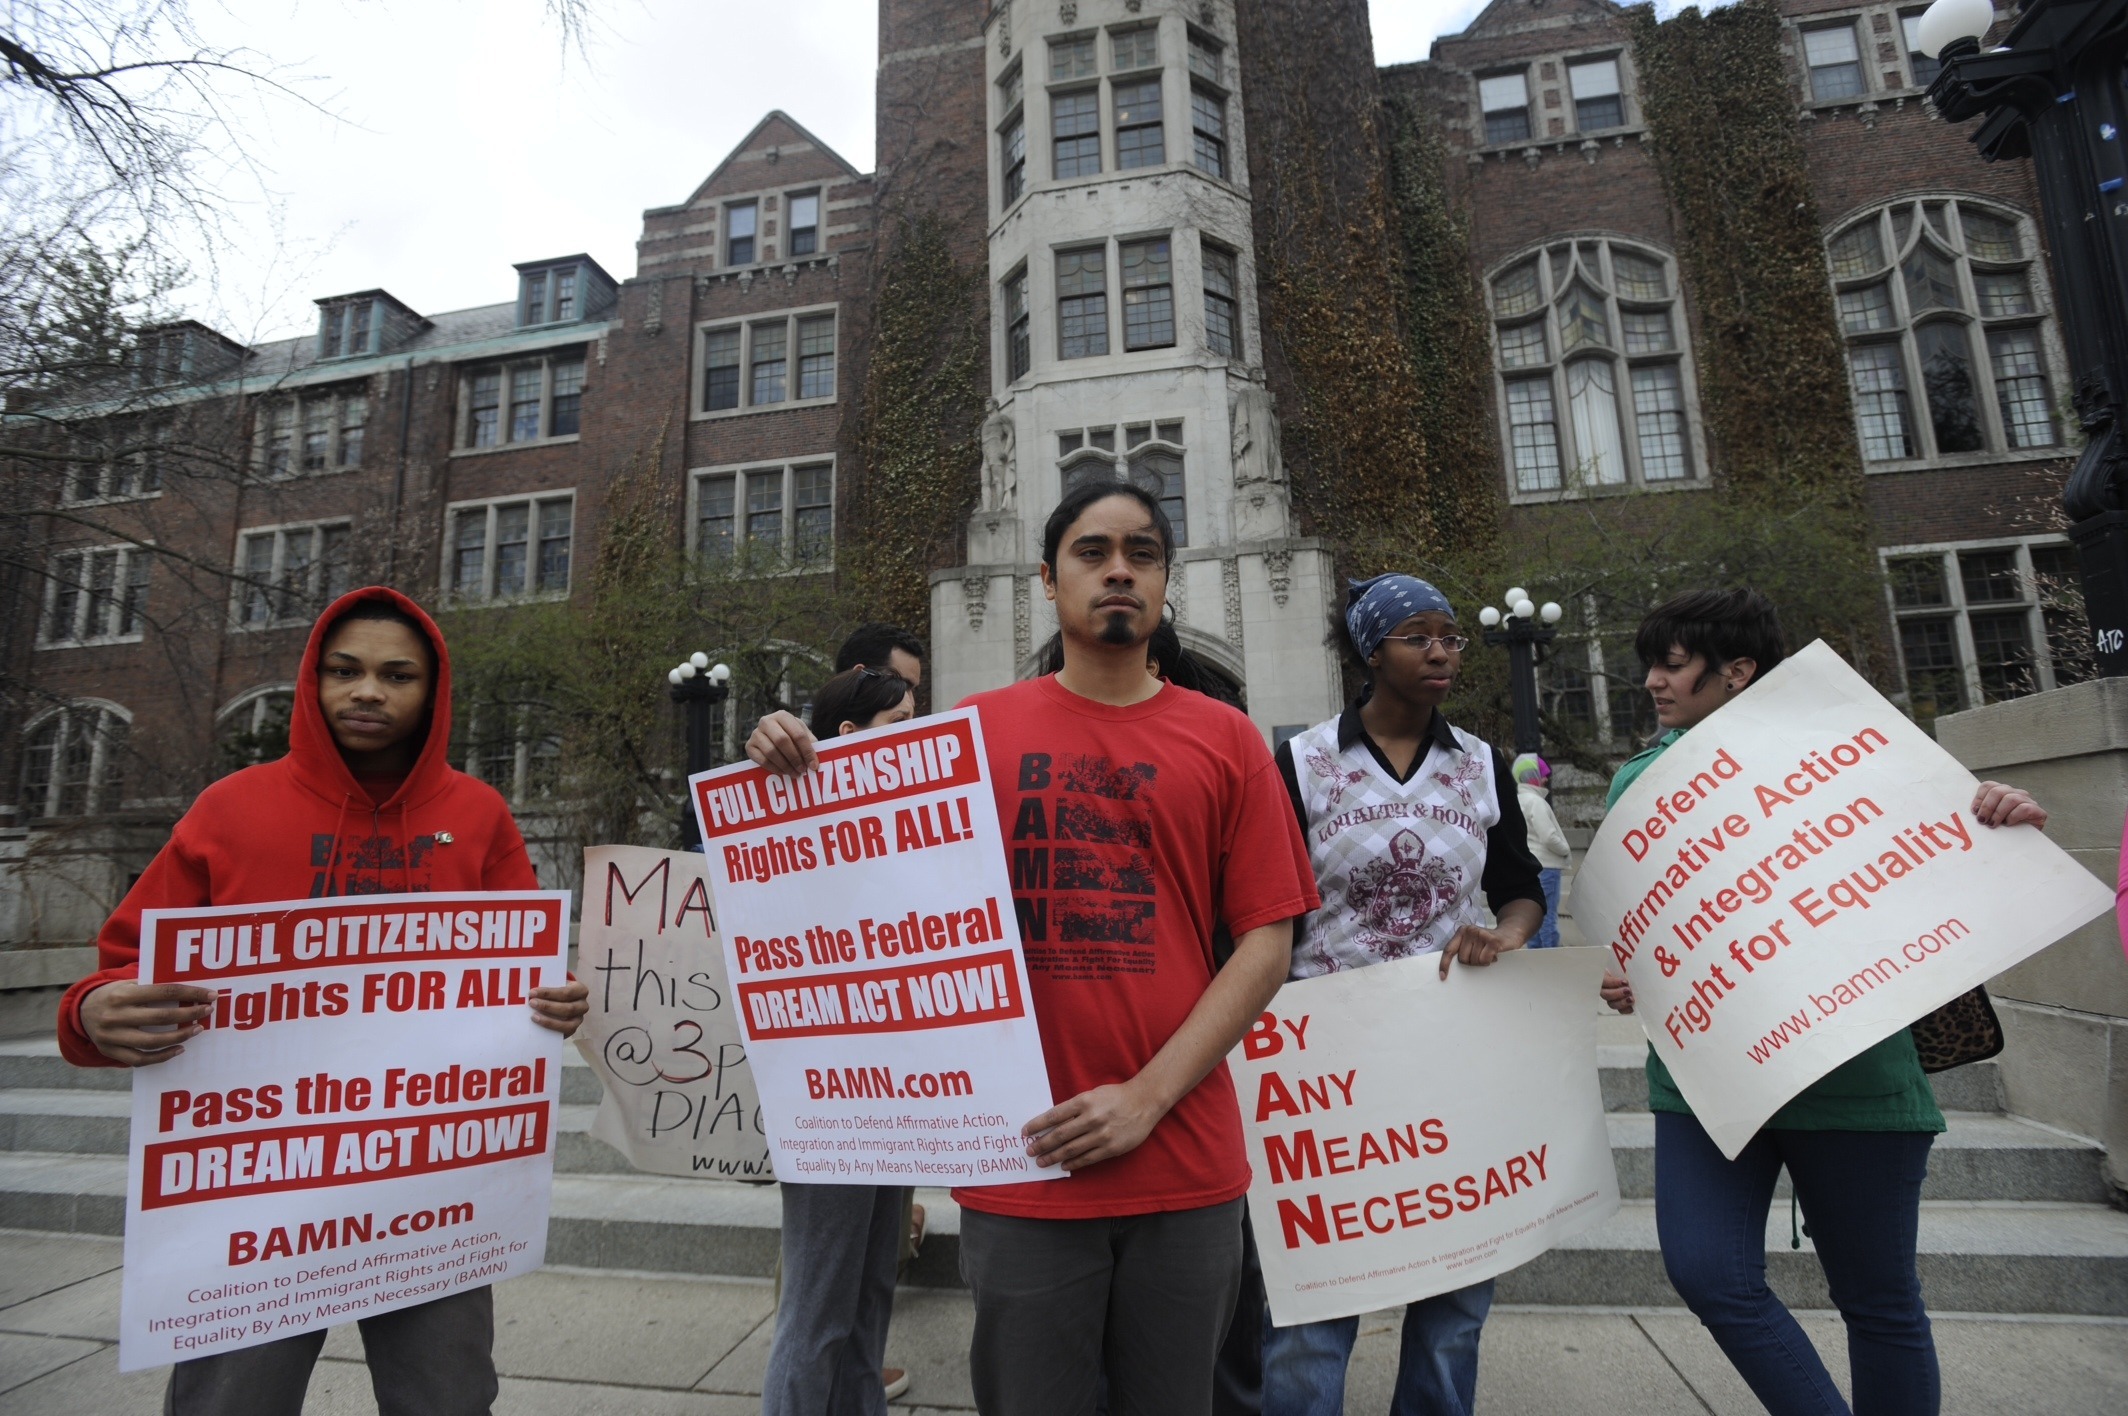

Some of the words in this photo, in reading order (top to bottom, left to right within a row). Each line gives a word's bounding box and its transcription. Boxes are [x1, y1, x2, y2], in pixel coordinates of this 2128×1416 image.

[706, 780, 767, 828] FULL
[765, 734, 961, 814] CITIZENSHIP
[1622, 748, 1743, 862] Defend
[723, 835, 817, 883] Rights
[819, 816, 887, 866] FOR
[895, 797, 974, 853] ALL!
[1318, 802, 1410, 844] LOYALTY
[1413, 803, 1428, 818] &
[1611, 813, 1750, 973] Affirmative
[1753, 727, 1889, 818] Action
[605, 857, 716, 938] MA
[1654, 945, 1681, 978] &
[1672, 796, 1884, 951] Integration
[175, 922, 281, 973] FULL
[293, 909, 547, 960] CITIZENSHIP
[734, 935, 804, 974] Pass
[805, 925, 857, 965] the
[858, 896, 1003, 960] Federal
[1665, 963, 1736, 1049] Fight
[1728, 918, 1791, 973] for
[1788, 811, 1973, 928] Equality
[362, 971, 446, 1013] FOR
[595, 939, 721, 1012] this
[748, 984, 845, 1030] DREAM
[846, 979, 902, 1024] ACT
[907, 963, 1010, 1019] NOW!
[1747, 918, 1970, 1064] www.bamn.com
[1242, 1011, 1310, 1061] BY
[159, 1084, 283, 1133] Pass
[296, 1073, 371, 1115] the
[384, 1057, 546, 1109] Federal
[805, 1066, 973, 1100] BAMN.com
[1256, 1069, 1356, 1122] ANY
[160, 1136, 325, 1197] DREAM
[333, 1127, 419, 1176] ACT
[428, 1112, 537, 1163] NOW!
[779, 1138, 834, 1153] Integration
[837, 1139, 856, 1151] and
[859, 1137, 916, 1154] Immigrant
[917, 1137, 954, 1155] Rights
[957, 1136, 980, 1151] and
[984, 1135, 1018, 1152] Fight
[794, 1116, 839, 1129] Coalition
[841, 1117, 852, 1129] to
[854, 1115, 893, 1129] Defend
[896, 1115, 959, 1129] Affirmative
[962, 1113, 1008, 1128] Action,
[1263, 1118, 1449, 1185] MEANS
[796, 1158, 836, 1175] Equality
[838, 1158, 851, 1175] By
[855, 1159, 874, 1175] Any
[877, 1159, 912, 1173] Means
[914, 1160, 973, 1177] Necessary
[977, 1157, 1028, 1176] (BAMN)
[1276, 1143, 1547, 1249] NECESSARY
[187, 1280, 268, 1304] Coalition
[274, 1276, 291, 1289] to
[296, 1259, 357, 1285] Defend
[361, 1242, 447, 1270] Affirmative
[450, 1230, 502, 1251] Action,
[228, 1201, 474, 1267] BAMN.com
[1295, 1280, 1328, 1292] Coalition
[1329, 1278, 1337, 1286] to
[1339, 1273, 1366, 1284] Defend
[1367, 1264, 1406, 1279] Affirmative
[1408, 1259, 1431, 1270] Action
[1432, 1256, 1438, 1264] &
[1439, 1246, 1475, 1262] Integration
[1476, 1240, 1489, 1251] and
[1489, 1234, 1506, 1247] Fight
[1505, 1231, 1514, 1240] for
[1515, 1221, 1537, 1237] Equality
[1537, 1217, 1545, 1228] By
[1556, 1203, 1573, 1216] Means
[1446, 1248, 1498, 1271] www.bamn.com
[149, 1304, 251, 1333] Integration
[256, 1293, 289, 1313] and
[295, 1275, 380, 1304] Immigrant
[385, 1262, 433, 1284] Rights
[437, 1252, 465, 1272] and
[469, 1245, 505, 1267] Fight
[508, 1240, 528, 1253] for
[174, 1325, 247, 1350] Equality
[252, 1319, 274, 1335] By
[278, 1311, 311, 1328] Any
[316, 1297, 369, 1319] Means
[374, 1278, 450, 1305] Necessary
[454, 1260, 508, 1287] (BAMN)
